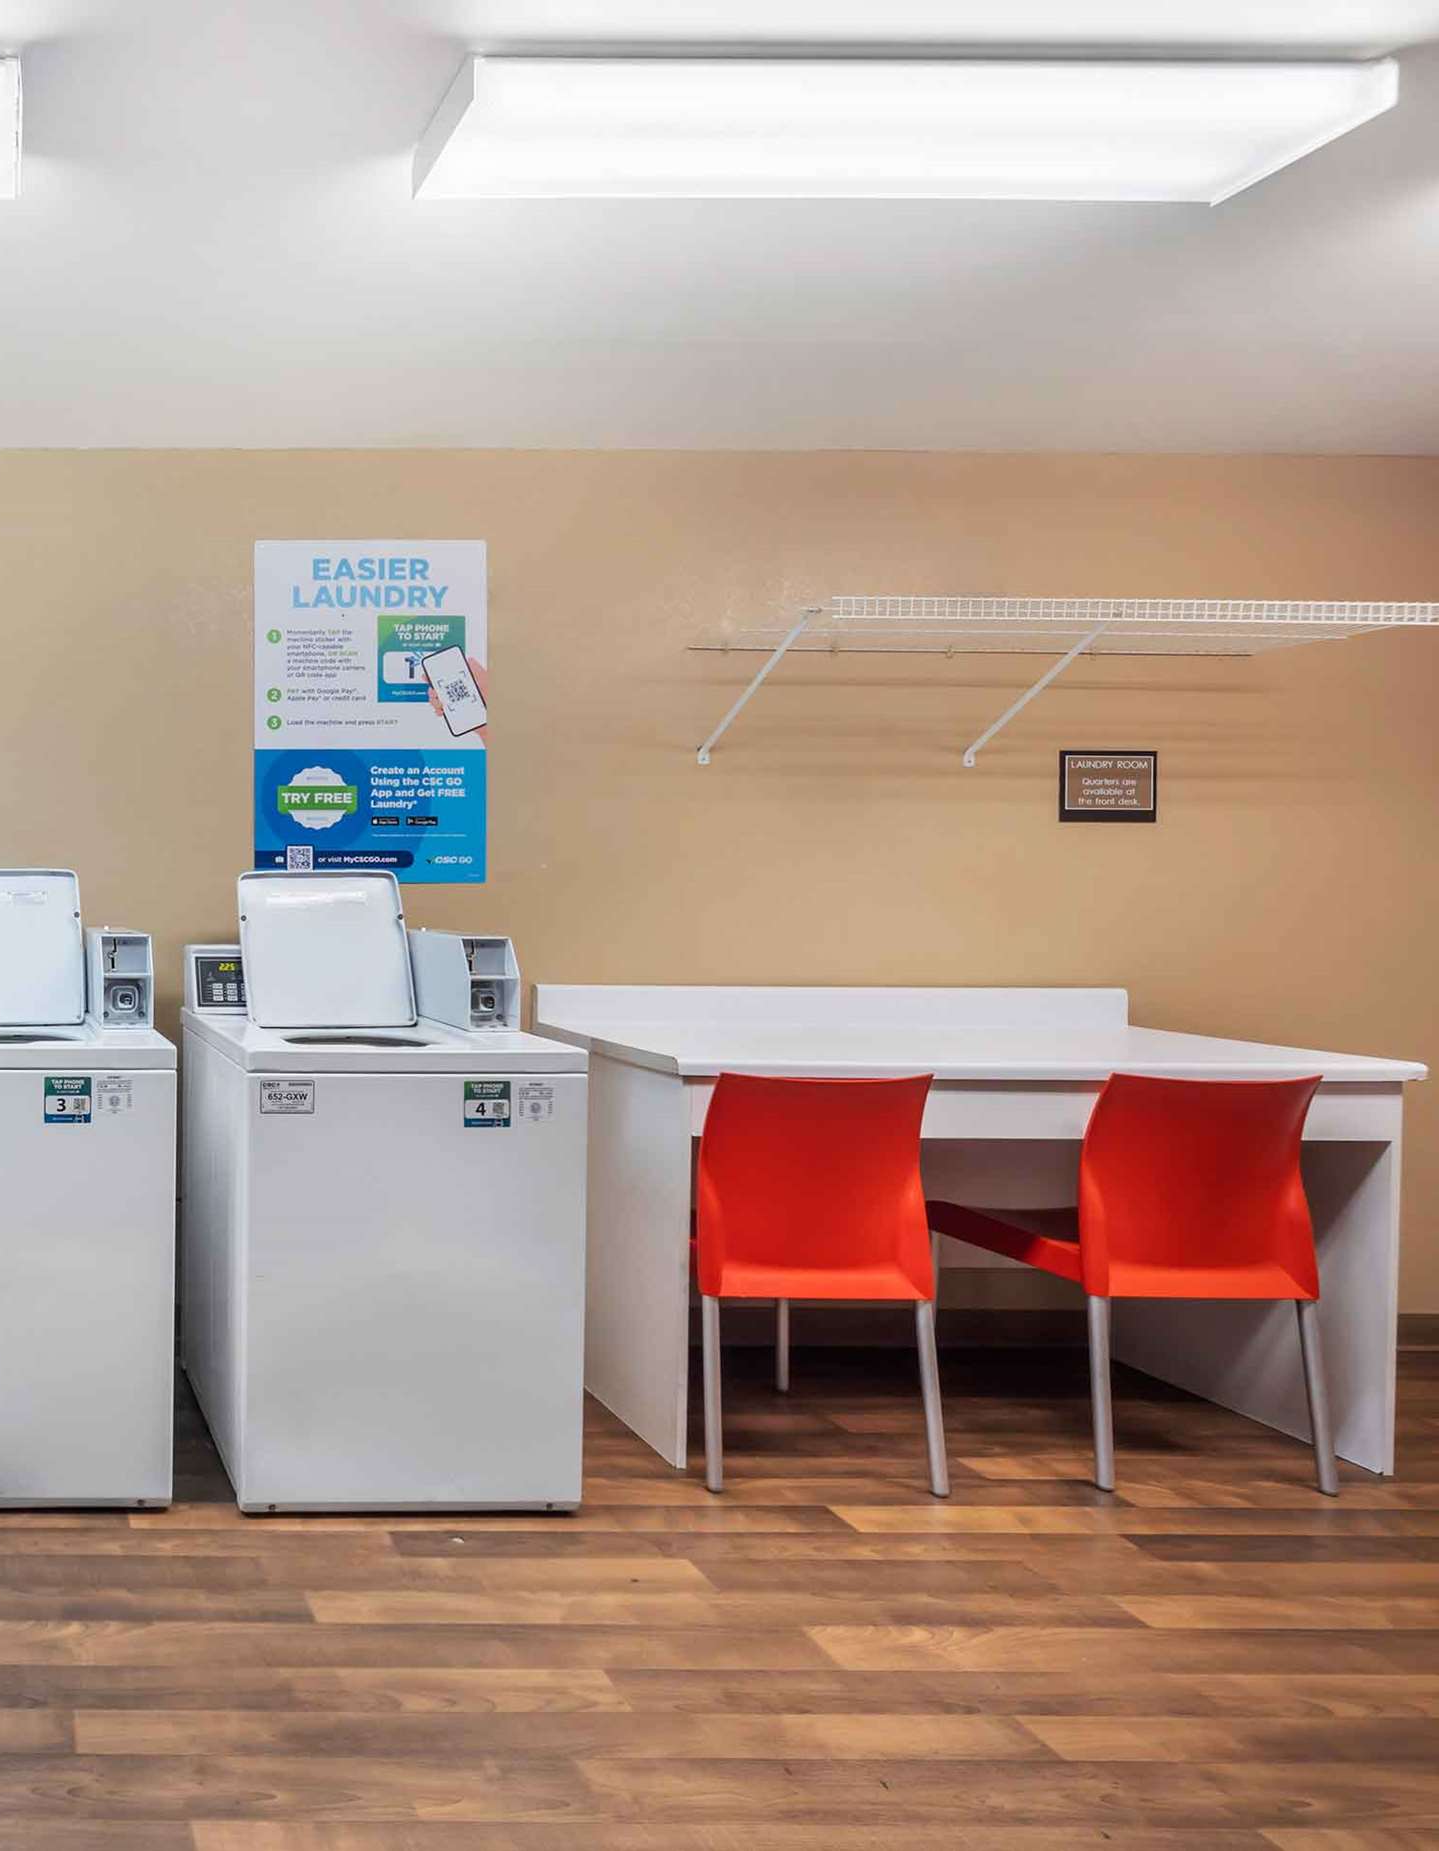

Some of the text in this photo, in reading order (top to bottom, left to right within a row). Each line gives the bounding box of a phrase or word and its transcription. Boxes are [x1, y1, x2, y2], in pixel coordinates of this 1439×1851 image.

[312, 558, 430, 580] EASIER
[292, 585, 448, 608] LAUNDRY
[394, 624, 449, 632] TAP PHONE
[271, 632, 277, 640] 1
[271, 691, 278, 699] 2
[271, 718, 278, 727] 3
[1071, 761, 1148, 769] LAUNDRY ROOM
[370, 766, 405, 775] Create
[422, 766, 465, 775] Account
[371, 777, 462, 787] Using the CSC GO
[371, 788, 465, 798] App and Get FREE
[1082, 787, 1136, 796] available at
[281, 793, 353, 804] TRY FREE
[1078, 798, 1092, 806] the
[1095, 798, 1115, 806] front
[458, 856, 472, 864] GO
[268, 1093, 308, 1101] 652-GXW
[56, 1098, 66, 1112] 3
[475, 1102, 486, 1116] 4
